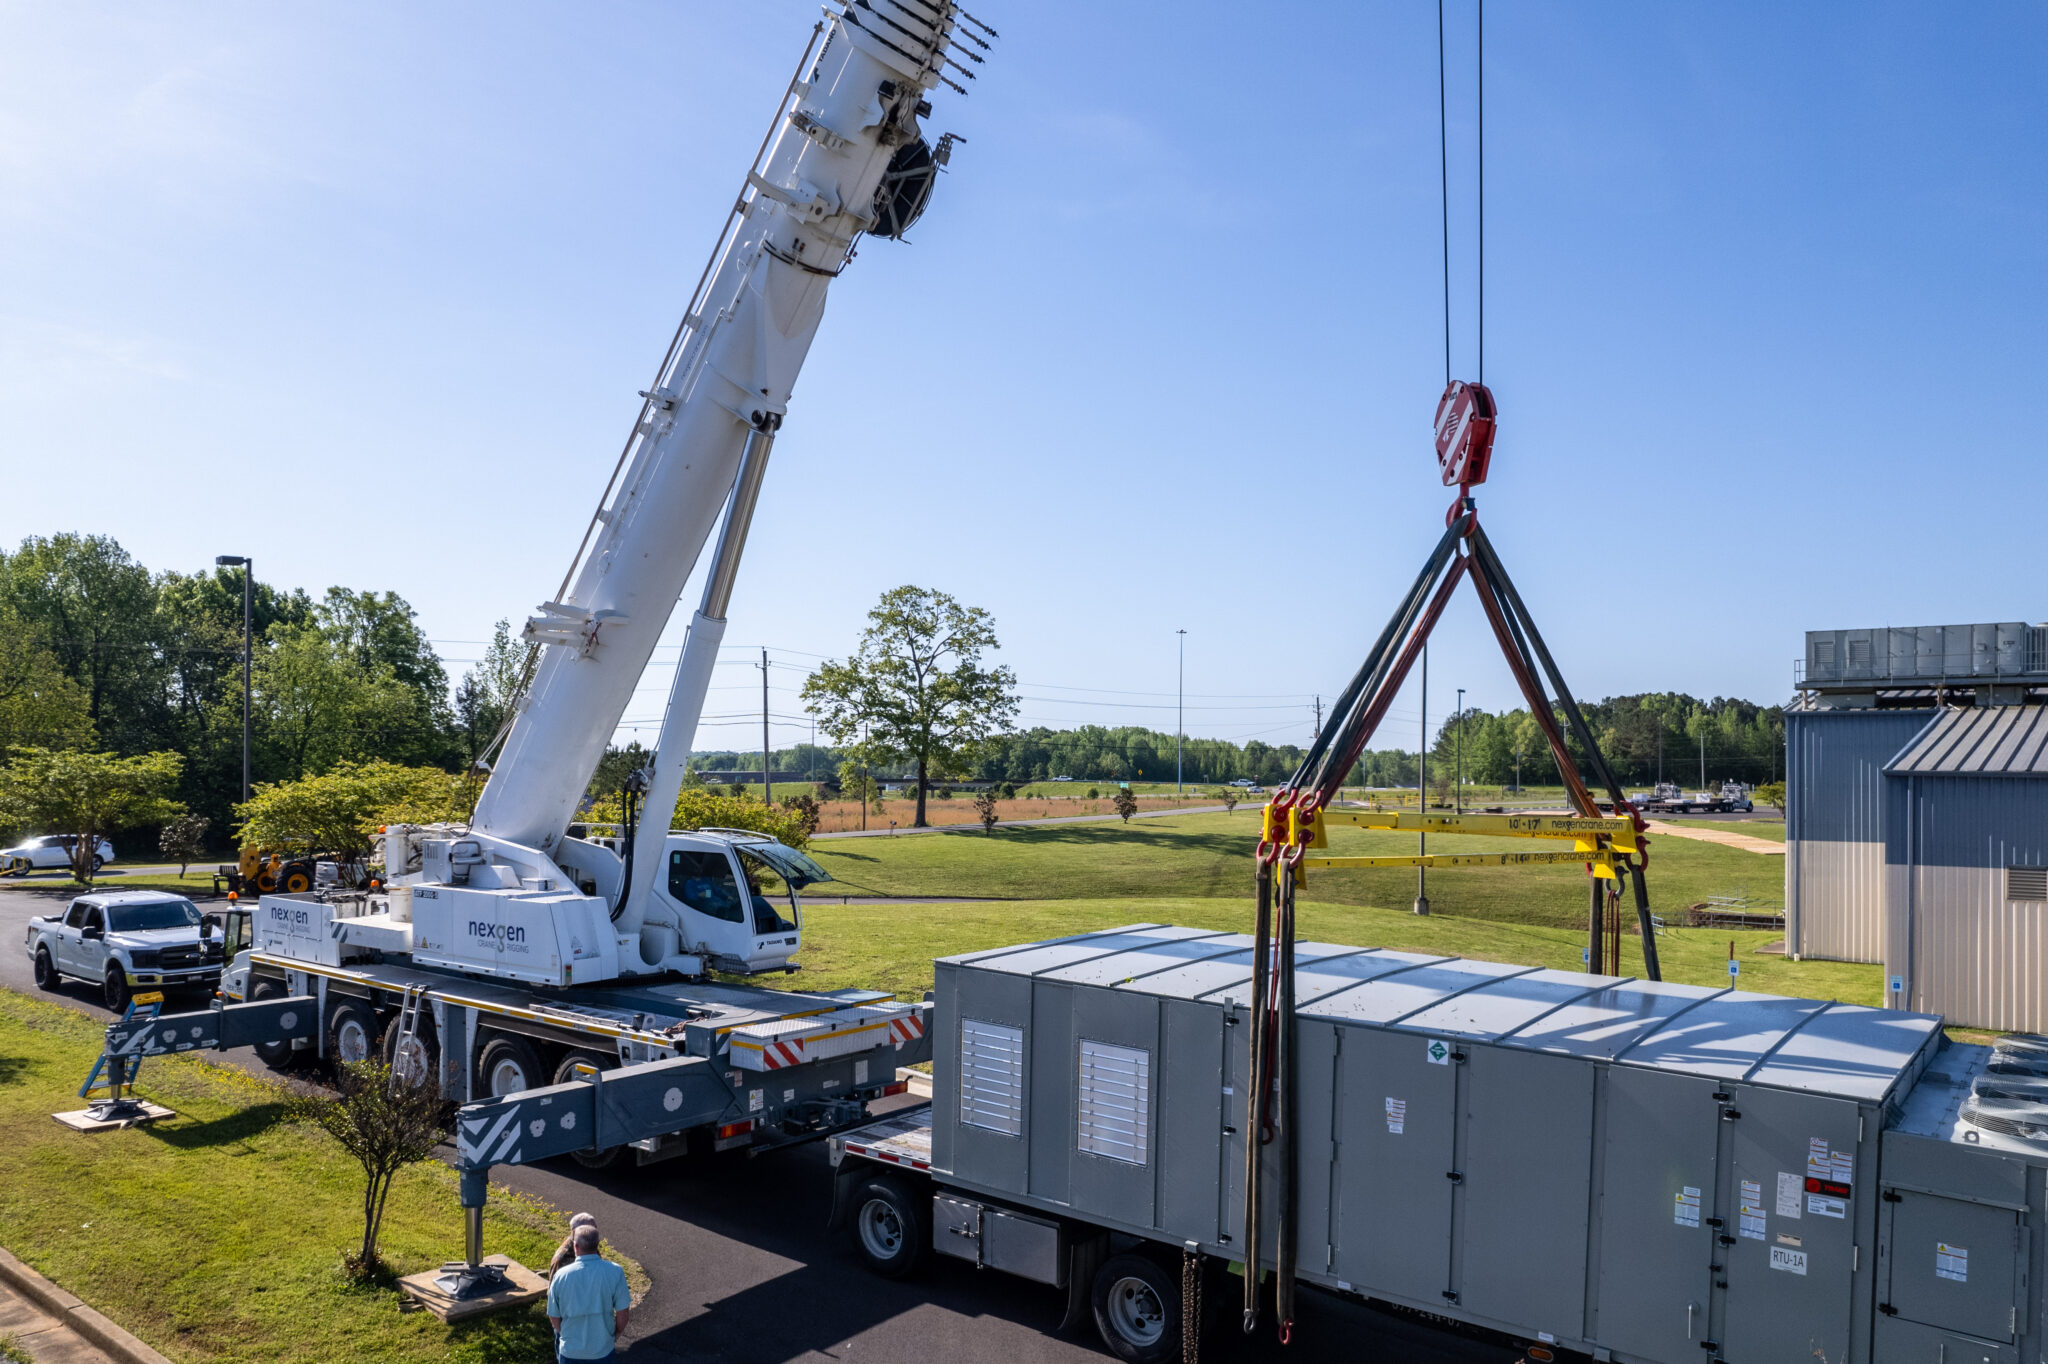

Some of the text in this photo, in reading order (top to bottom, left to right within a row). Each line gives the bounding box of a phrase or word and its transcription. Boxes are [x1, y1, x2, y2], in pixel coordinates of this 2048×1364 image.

[818, 29, 836, 62] TADANO
[1551, 820, 1624, 832] nexgencrane.com
[1534, 851, 1604, 864] nexgencrane.com
[271, 906, 308, 933] nexgen
[468, 920, 525, 953] nexgen
[477, 939, 529, 953] CRANE RIGGING
[1773, 1250, 1804, 1268] RTU-1A
